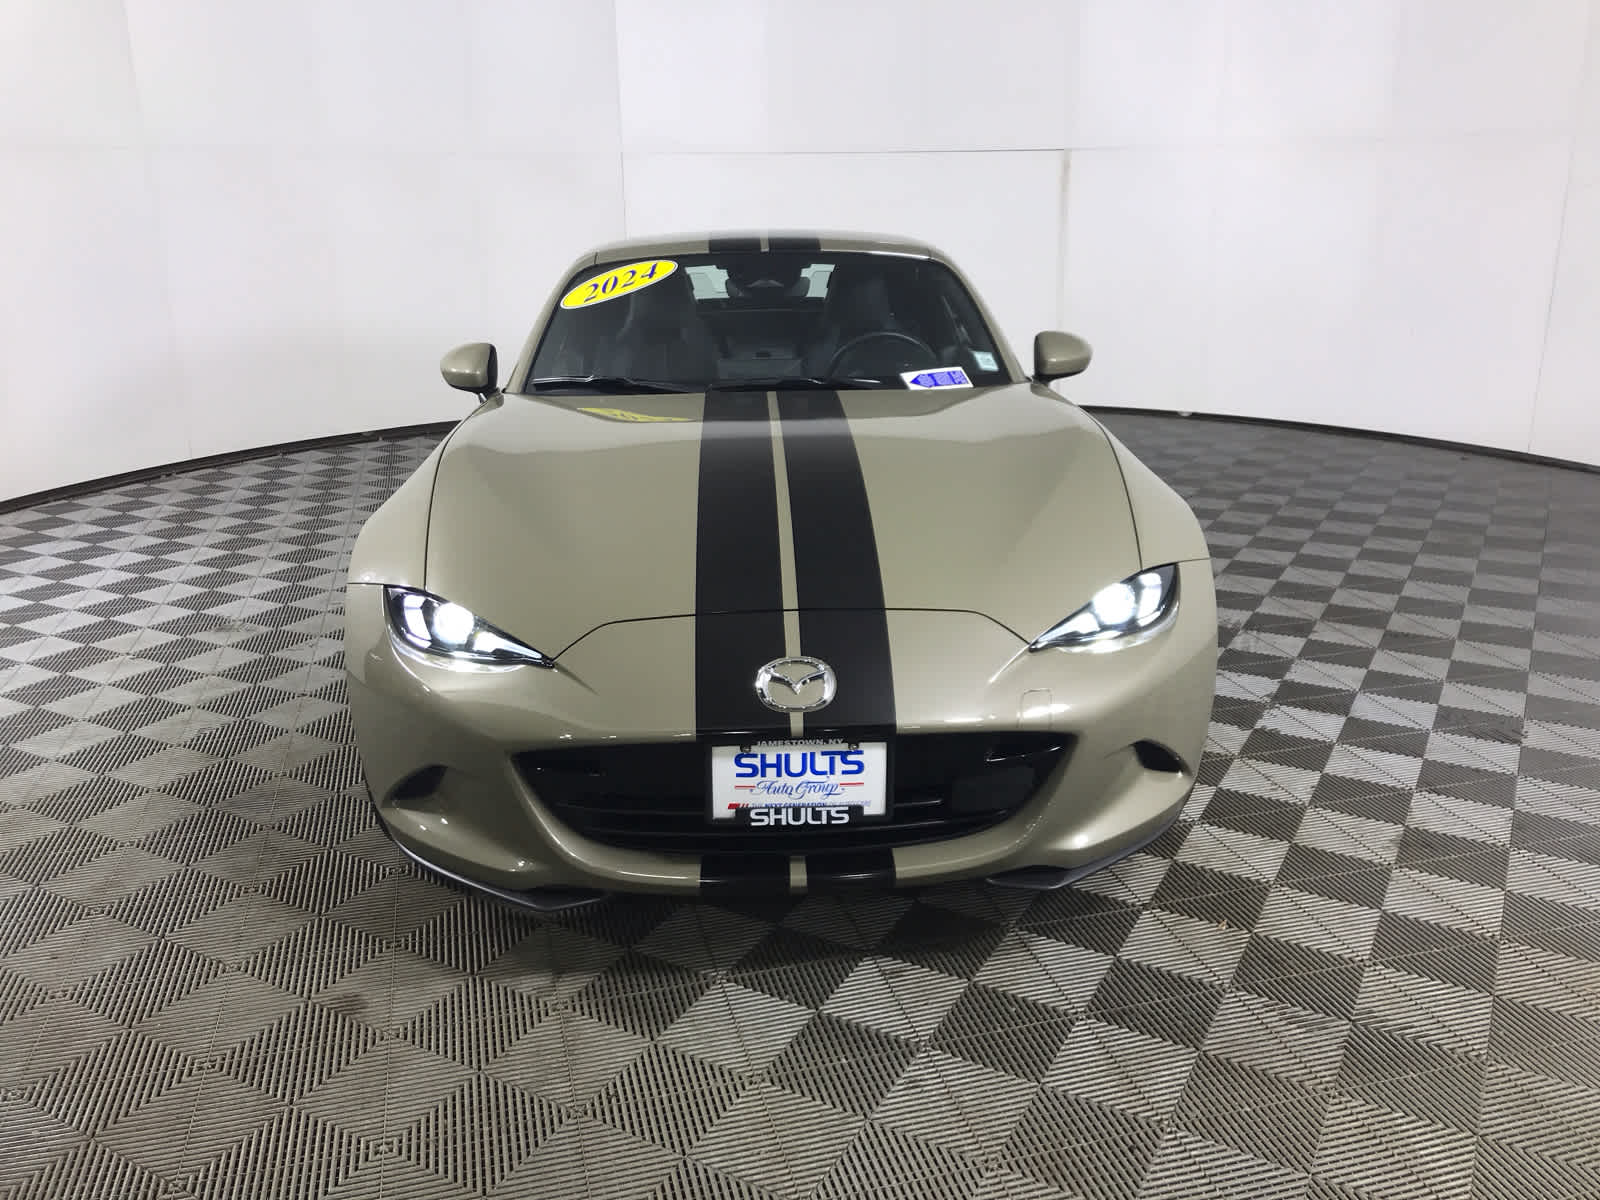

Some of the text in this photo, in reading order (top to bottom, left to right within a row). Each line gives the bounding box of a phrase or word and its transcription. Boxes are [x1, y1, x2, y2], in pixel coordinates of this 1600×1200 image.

[584, 262, 658, 302] 2024
[828, 738, 844, 746] NY
[734, 750, 865, 778] SHULTS
[757, 780, 841, 800] Auto Group
[750, 806, 850, 826] SHULTS
